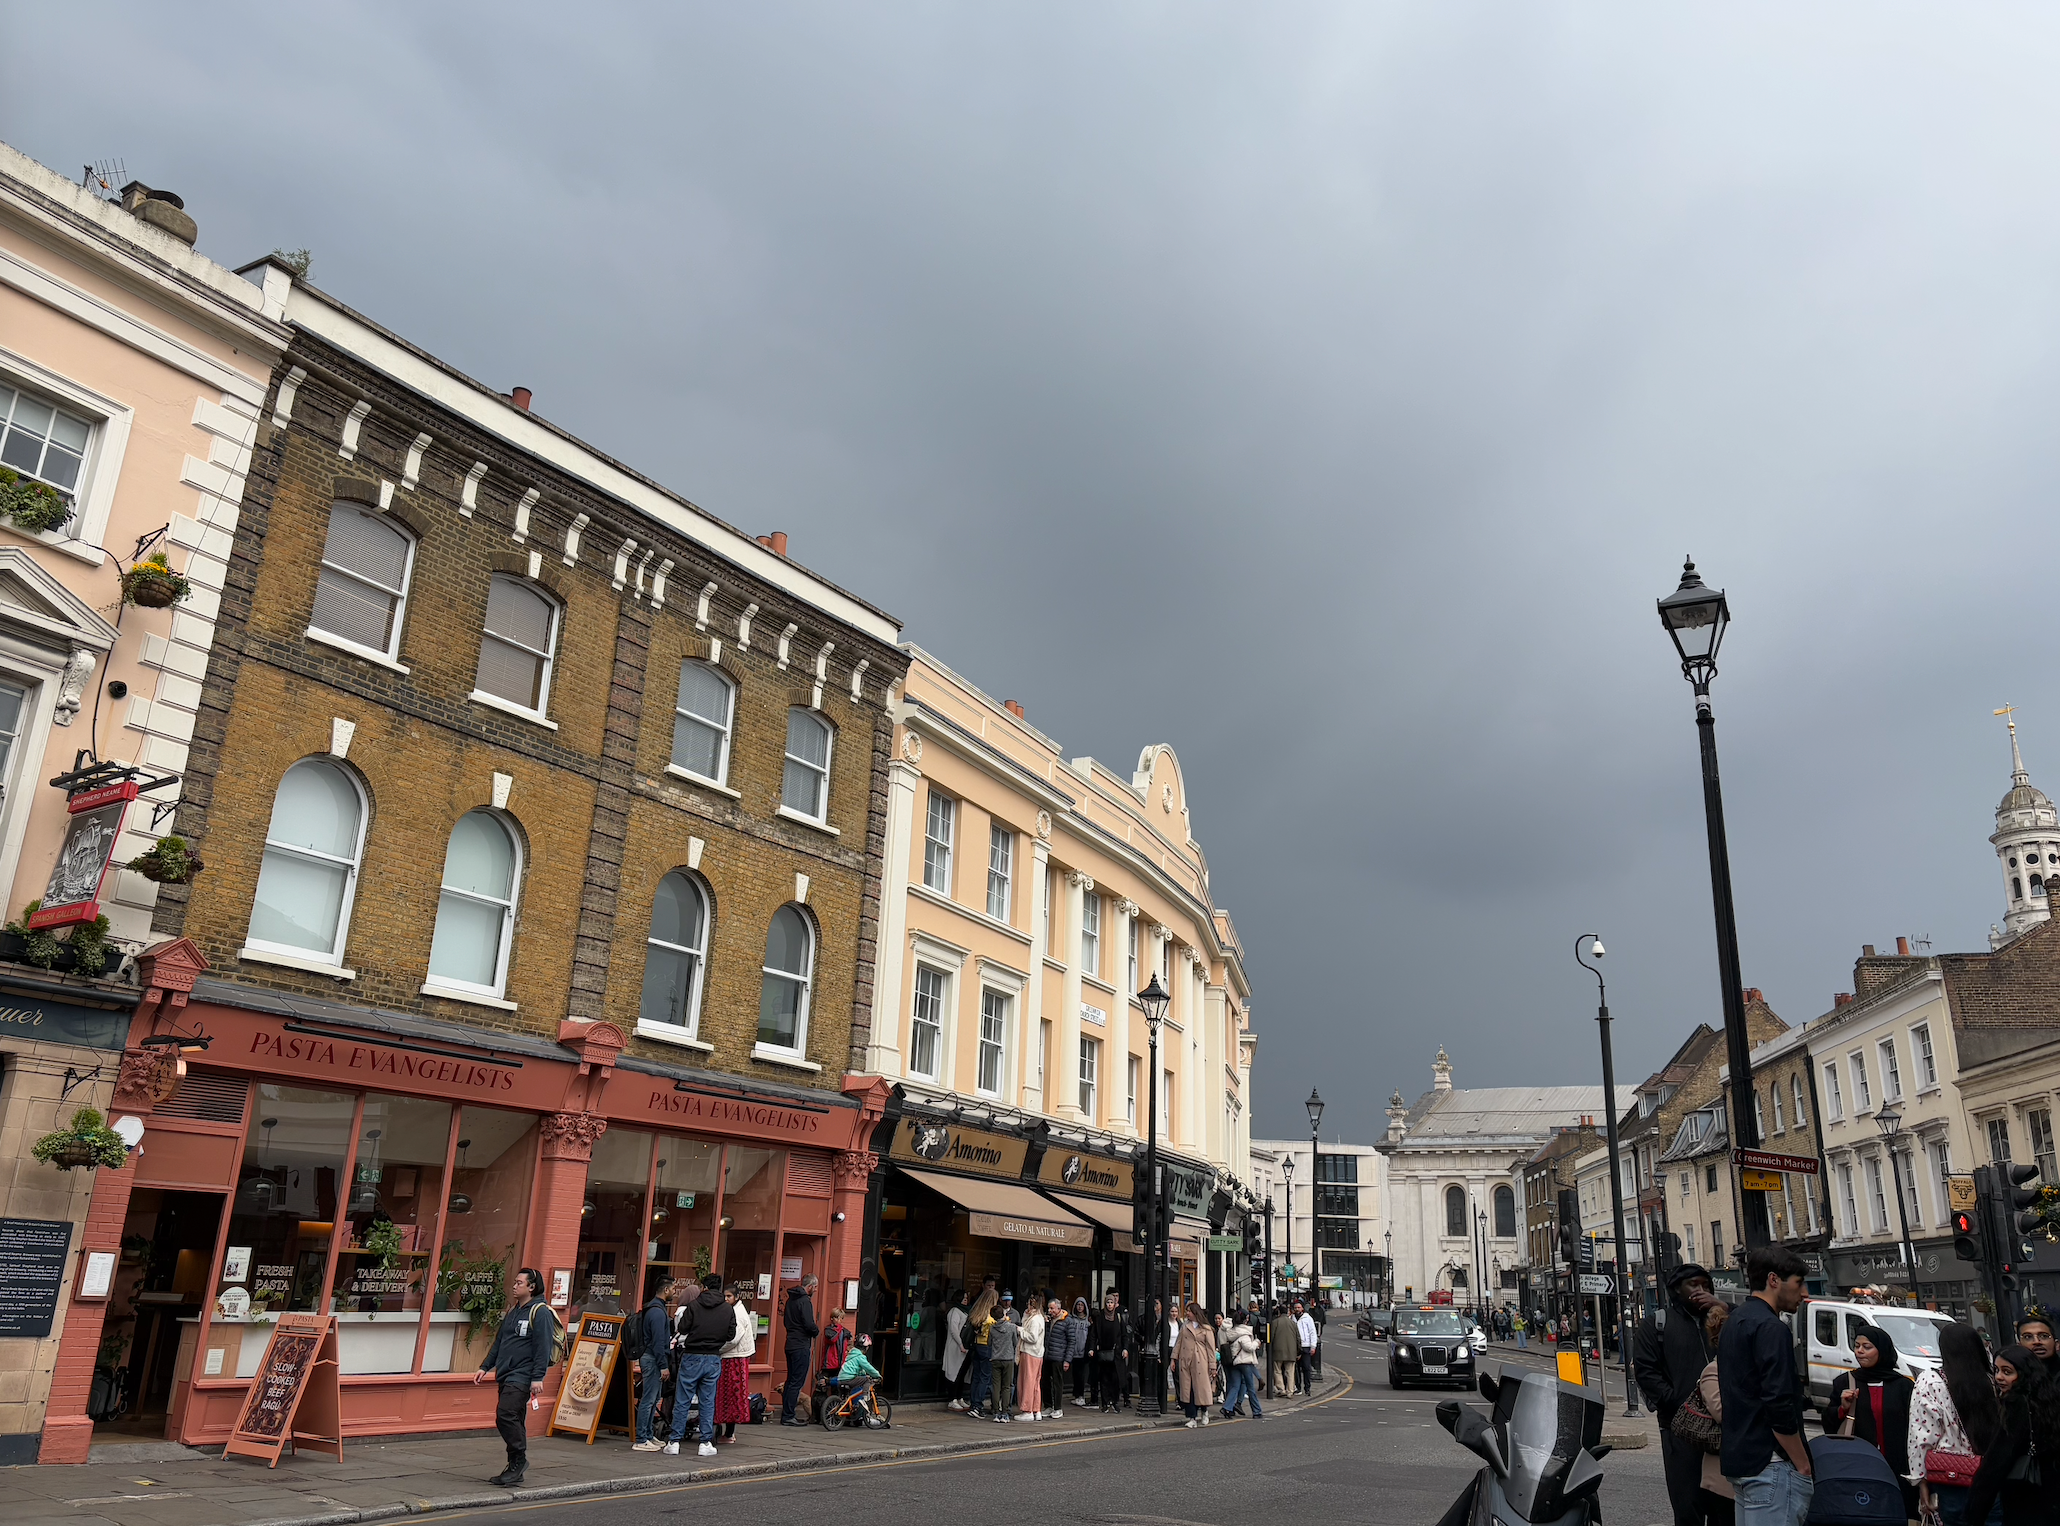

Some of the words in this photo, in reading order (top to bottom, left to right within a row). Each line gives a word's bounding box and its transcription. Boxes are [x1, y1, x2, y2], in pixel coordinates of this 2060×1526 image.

[72, 793, 101, 806] SHEPHERD
[102, 787, 121, 798] NEAME
[31, 911, 55, 924] SPANISH
[56, 906, 83, 919] GALLEON
[250, 1031, 336, 1065] PASTA
[348, 1047, 515, 1091] EVANGELISTS
[648, 1091, 701, 1116] PASTA
[710, 1101, 819, 1132] EVANGELISTS
[947, 1133, 1002, 1166] Amorino
[1784, 1158, 1815, 1170] Market
[1079, 1160, 1119, 1189] Amorino
[1003, 1221, 1027, 1234] GELATO
[1028, 1226, 1036, 1236] AL
[1036, 1227, 1065, 1238] NATURALE
[256, 1264, 295, 1277] FRESH
[357, 1268, 410, 1280] TAKEAWAY
[254, 1279, 290, 1291] PASTA
[591, 1274, 617, 1284] FRESH
[351, 1282, 359, 1292] &
[361, 1282, 409, 1293] DELIVERY
[471, 1284, 494, 1295] VINO
[589, 1285, 614, 1295] PASTA
[589, 1320, 613, 1333] PASTA
[273, 1362, 297, 1372] SLOW-
[266, 1374, 295, 1386] COOKED
[267, 1388, 286, 1398] BEEF
